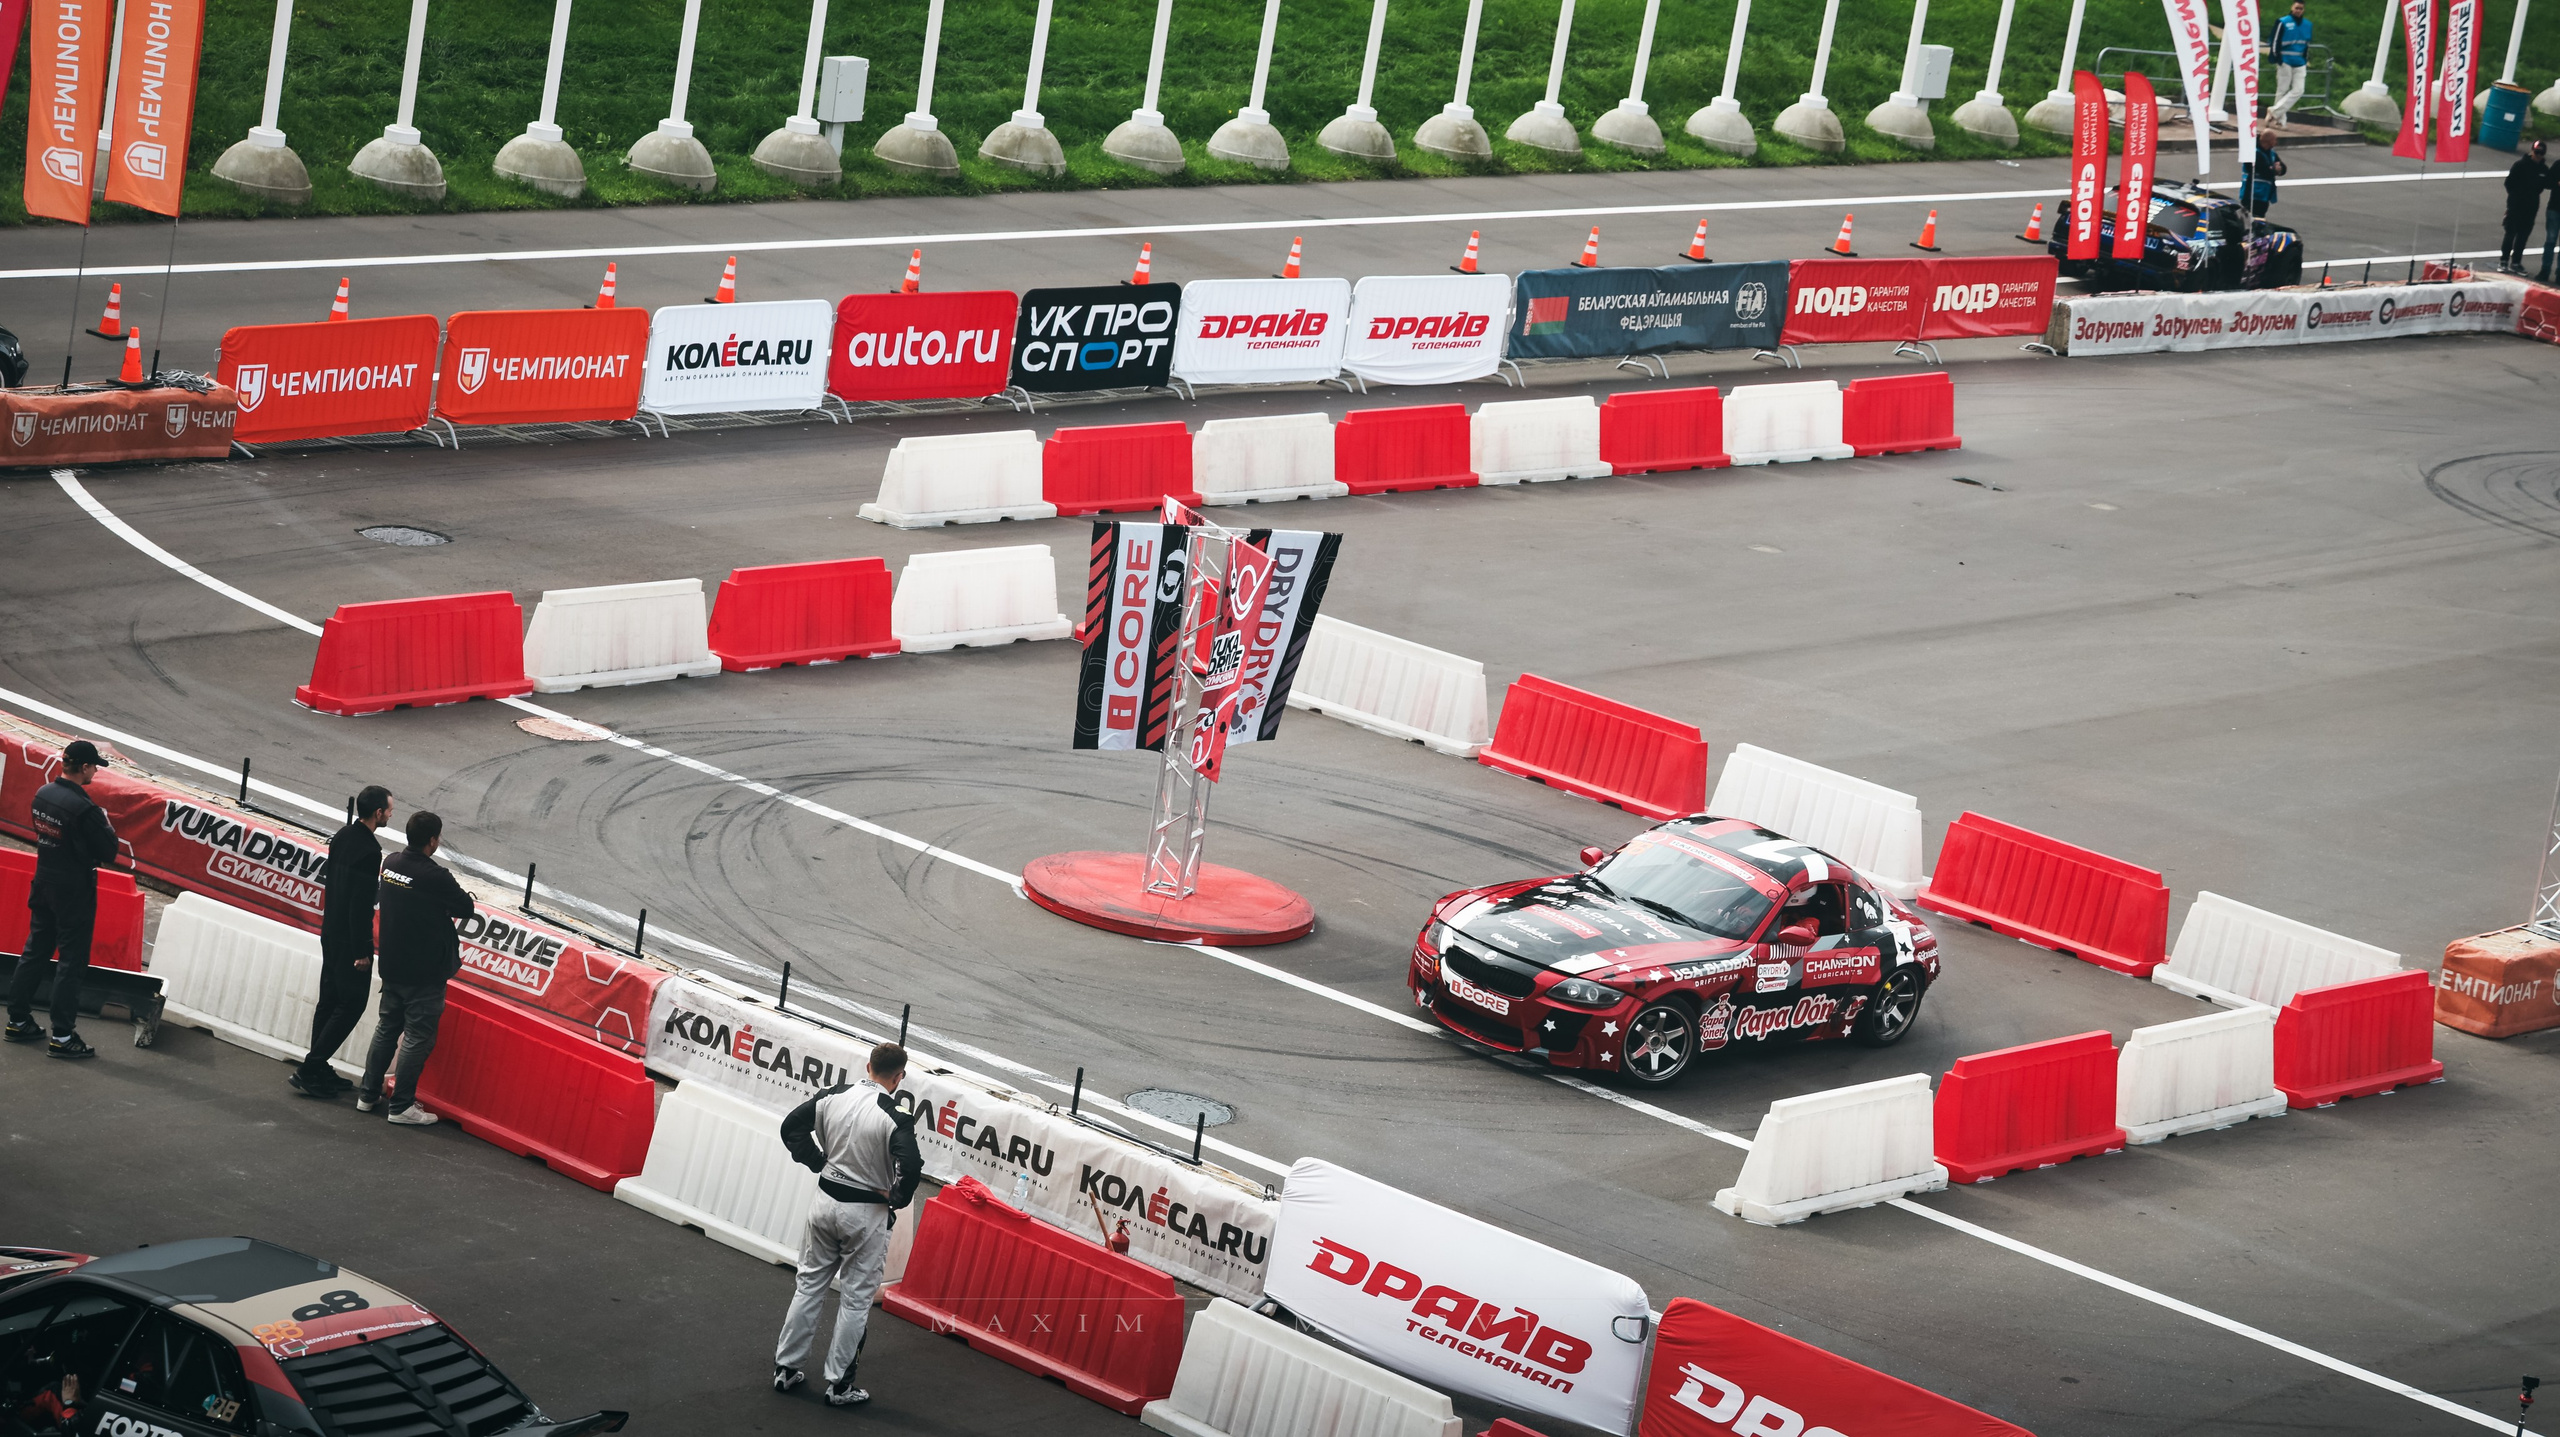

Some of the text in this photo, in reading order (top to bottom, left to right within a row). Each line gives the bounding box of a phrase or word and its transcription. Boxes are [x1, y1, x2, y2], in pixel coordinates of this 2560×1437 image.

[1795, 286, 1868, 317] ЛОДЭ
[1869, 285, 1910, 297] ГАРАНТИЯ
[1933, 283, 2000, 314] ЛОДЭ
[2001, 281, 2039, 294] ГАРАНТИЯ
[1578, 294, 1646, 311] БЕЛАРУСКАЯ
[1867, 300, 1908, 313] КАЧЕСТВА
[1999, 296, 2037, 309] КАЧЕСТВА
[1030, 301, 1173, 337] VK ПРО
[1619, 312, 1683, 332] ФЕДЭРАЦЫЯ
[848, 326, 1000, 368] auto.ru
[1021, 337, 1169, 372] СПОРТ
[271, 363, 418, 397] ЧЕМПИОНАТ
[492, 354, 629, 382] ЧЕМПИОНАТ
[40, 413, 148, 436] ЧЕМПИОНАТ
[1243, 548, 1304, 692] DRYDRY
[1212, 633, 1240, 658] YUKA
[164, 800, 243, 852] YUKA
[218, 855, 322, 907] GYMKHANA
[382, 868, 414, 885] FORSE
[456, 912, 563, 968] DRIVE
[1670, 954, 1757, 982] USA GLOBAL
[1758, 966, 1783, 976] DRYDRY
[1806, 955, 1875, 973] CHAMPION
[1813, 969, 1863, 980] LUBRICANTS
[1694, 973, 1739, 988] DRIFT TEAM
[2440, 967, 2542, 1006] ЕМПИОНАТ
[1701, 1014, 1726, 1027] Papa
[1734, 1004, 1794, 1042] Papa
[662, 1037, 751, 1076] АВТОМОБИЛЬНЫЙ
[1174, 1239, 1262, 1280] ОНЛАЙН-ЖУРНАЛ
